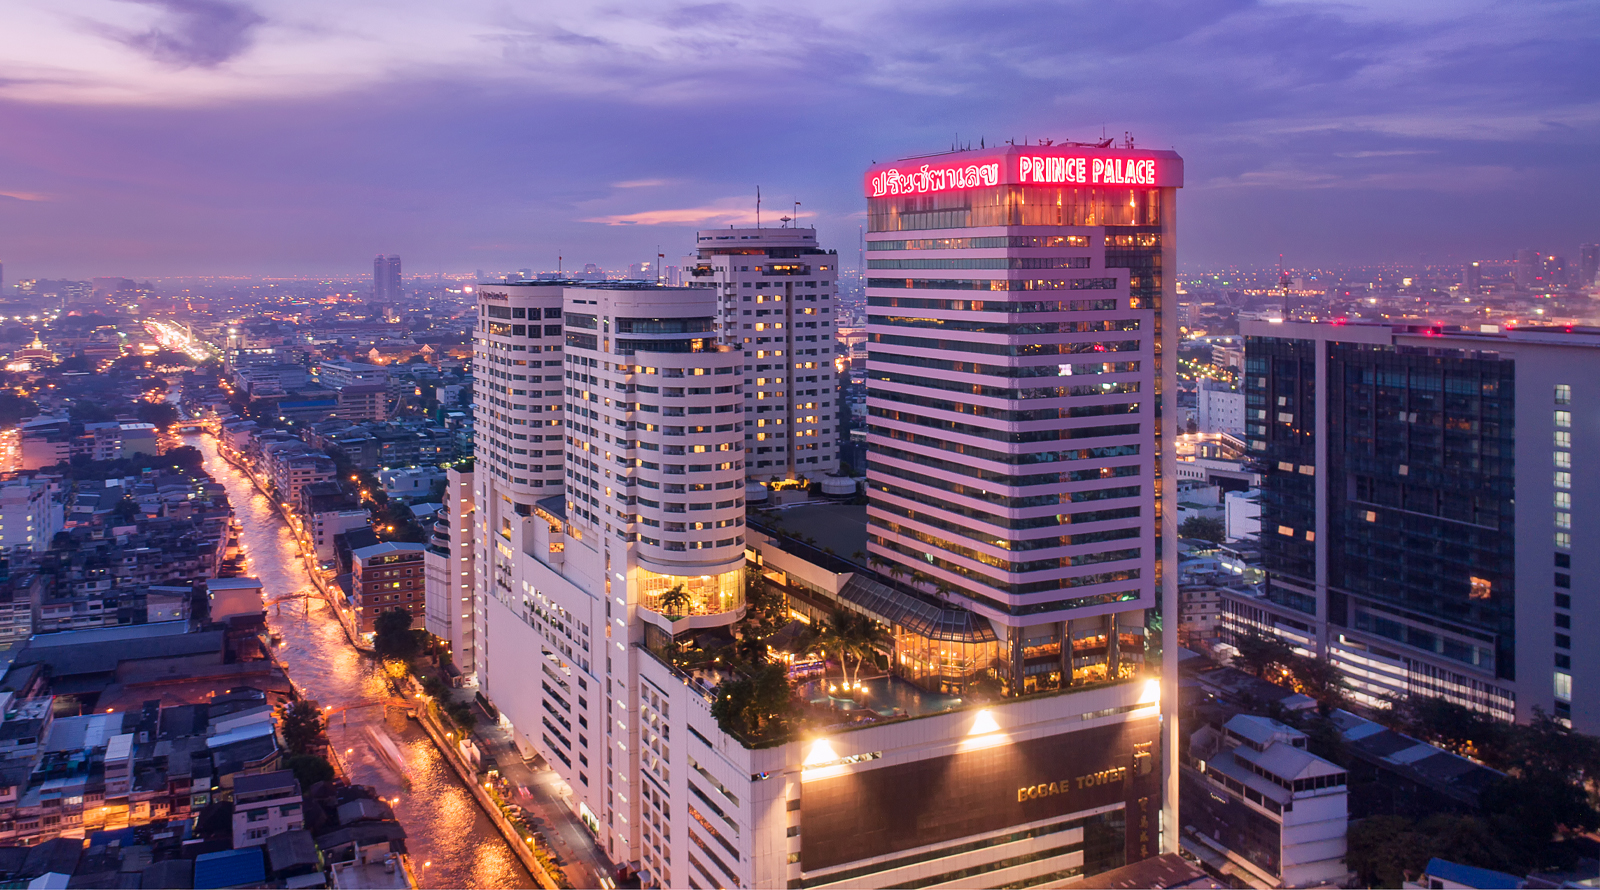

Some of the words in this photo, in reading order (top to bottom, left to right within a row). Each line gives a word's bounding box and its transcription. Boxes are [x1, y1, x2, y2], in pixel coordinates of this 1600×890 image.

[1020, 156, 1086, 183] PRINCE
[1092, 158, 1155, 184] PALACE
[1017, 780, 1069, 802] BOBAE
[1076, 766, 1127, 789] TOWER
